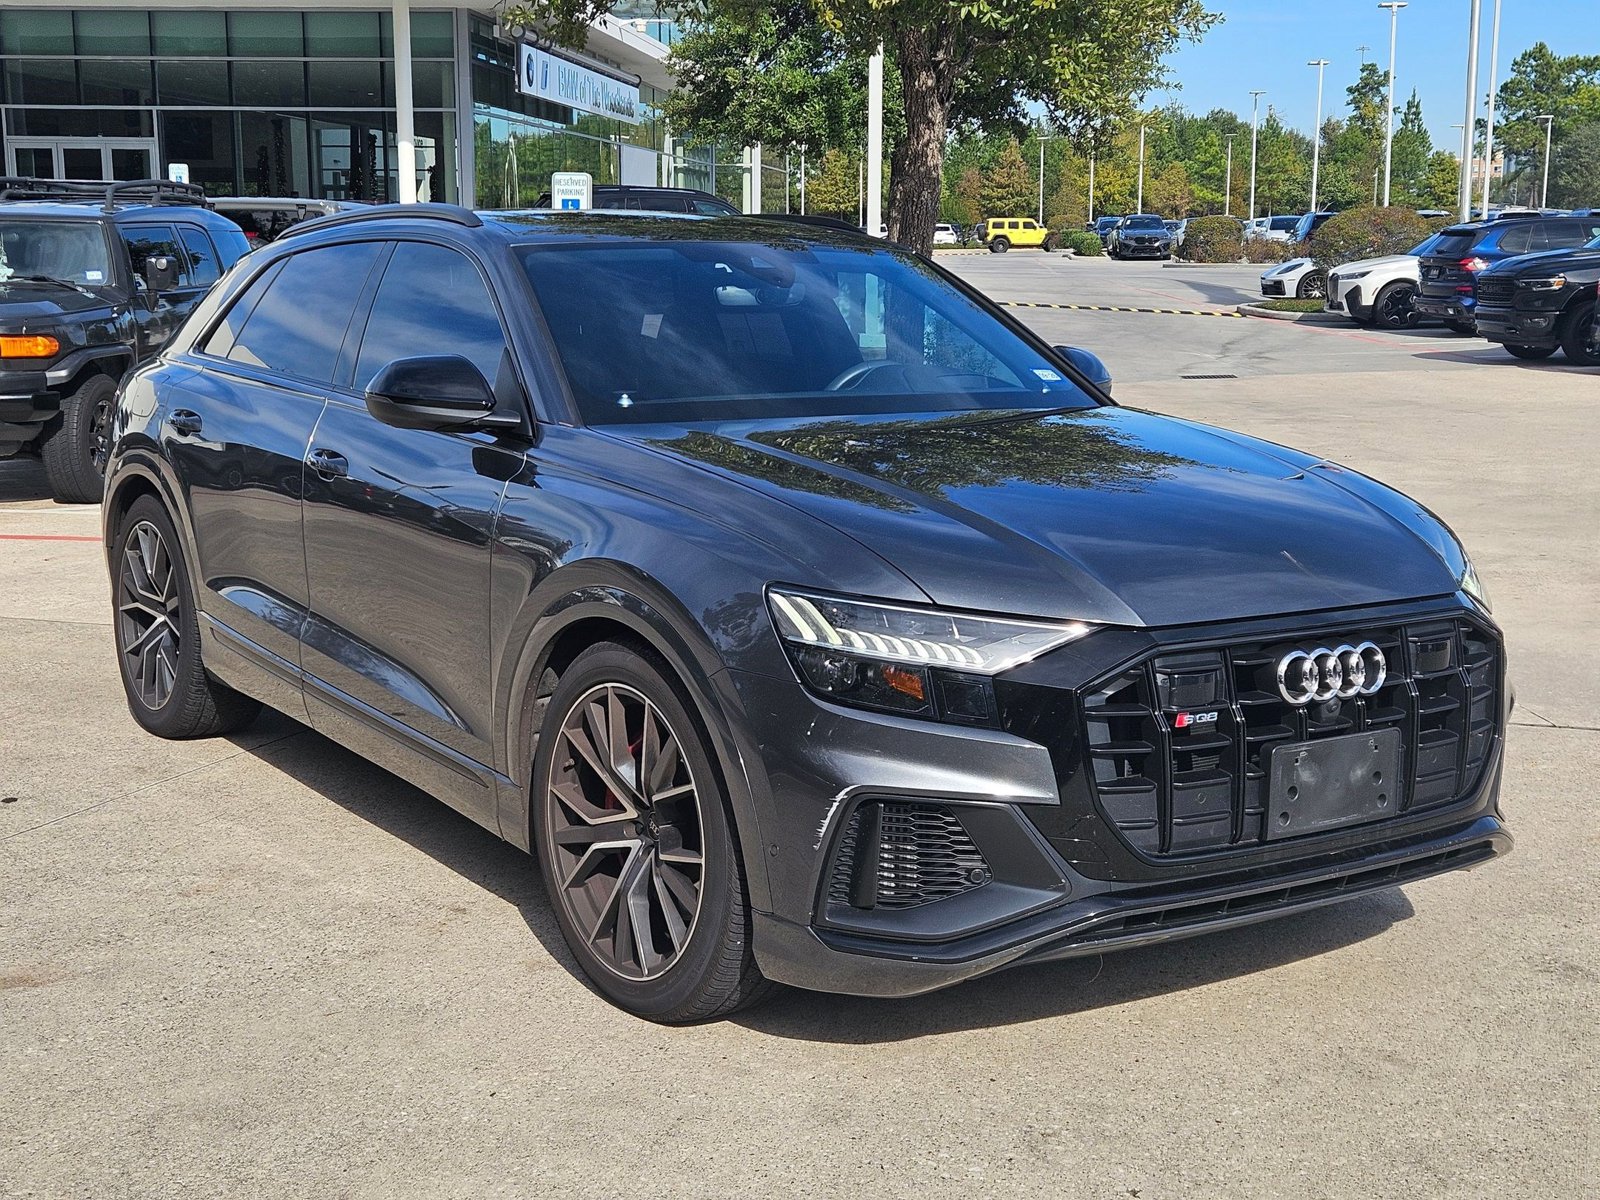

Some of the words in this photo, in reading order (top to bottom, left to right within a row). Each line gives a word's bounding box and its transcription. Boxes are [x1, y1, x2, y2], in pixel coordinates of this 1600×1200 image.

[558, 65, 579, 102] BMW
[579, 74, 588, 105] of
[587, 75, 601, 108] The
[600, 80, 635, 119] Woodlands
[554, 178, 587, 187] RESERVED
[557, 188, 585, 197] PARKING
